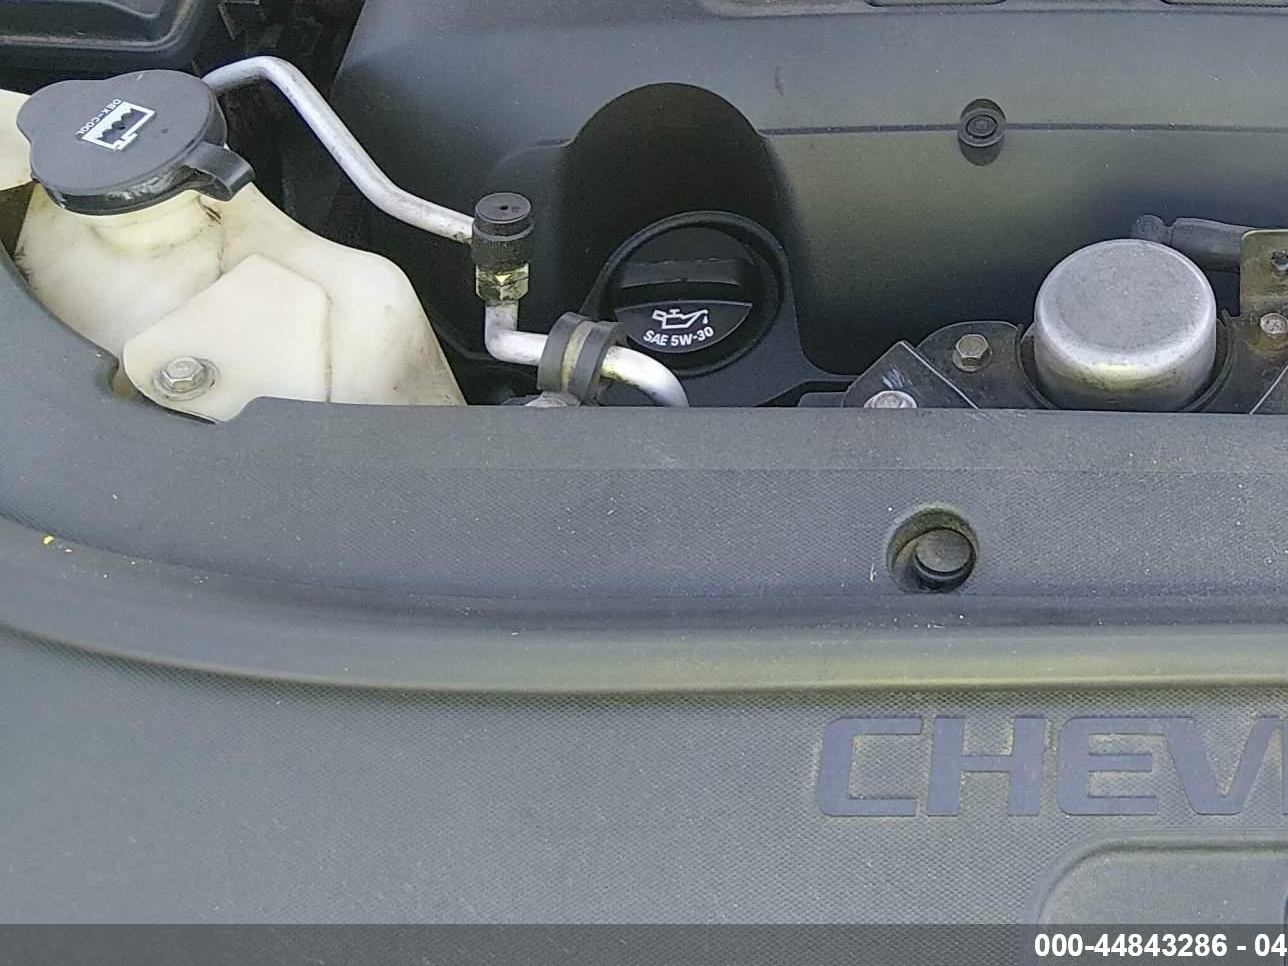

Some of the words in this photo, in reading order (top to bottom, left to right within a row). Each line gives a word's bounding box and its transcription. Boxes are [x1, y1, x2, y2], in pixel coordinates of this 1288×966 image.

[75, 98, 122, 136] DEX-COOL
[643, 329, 669, 347] SAE
[670, 326, 714, 347] 5W-30
